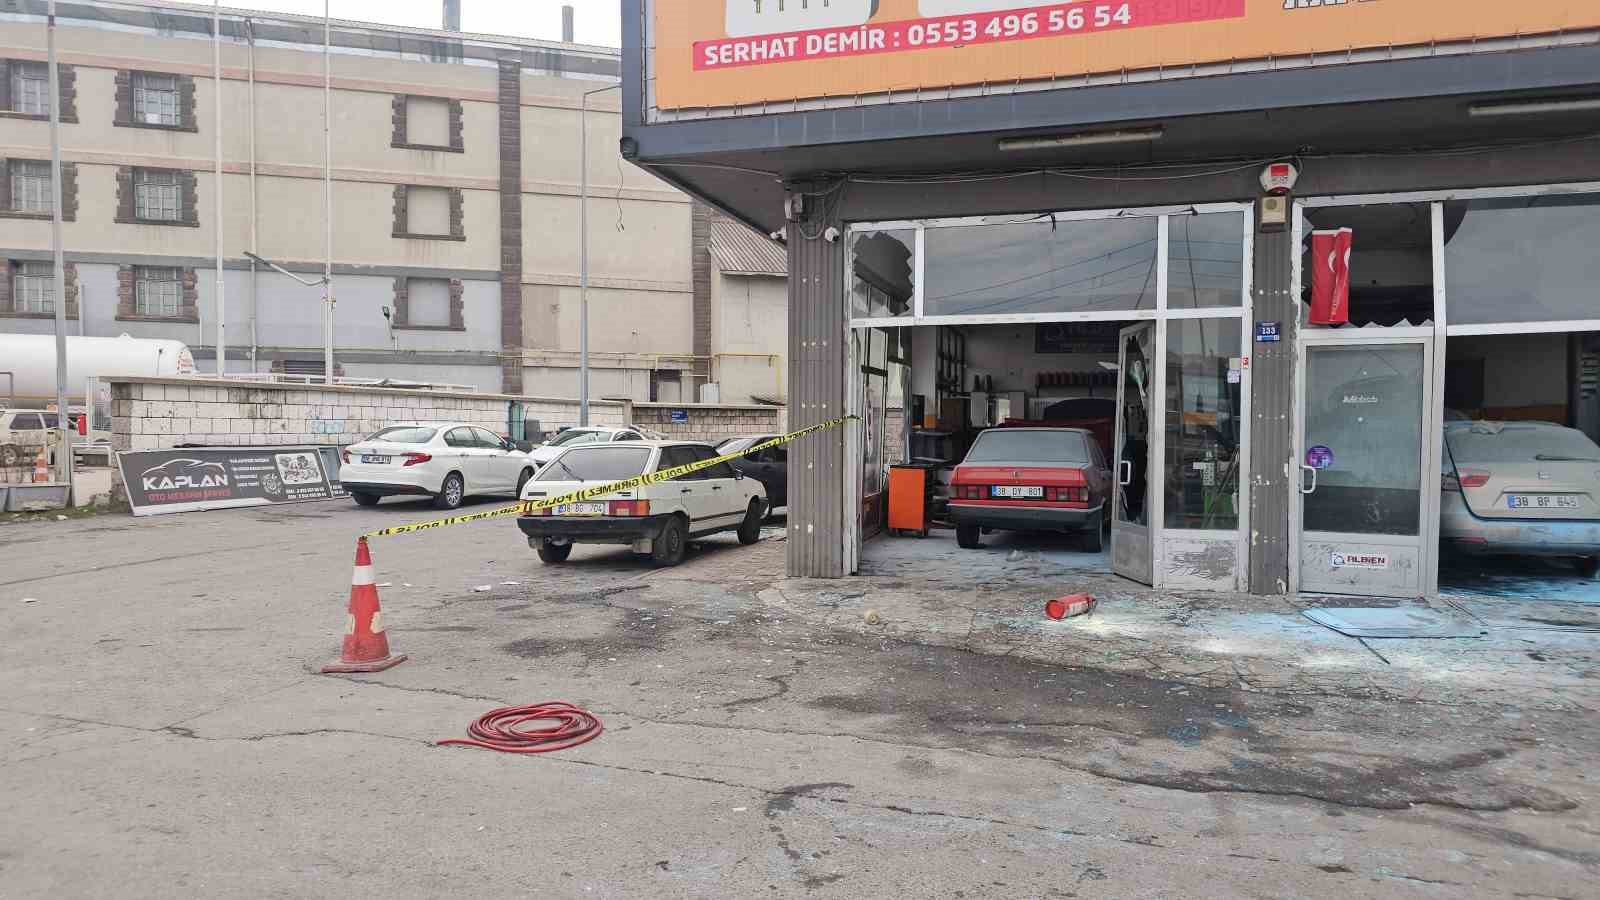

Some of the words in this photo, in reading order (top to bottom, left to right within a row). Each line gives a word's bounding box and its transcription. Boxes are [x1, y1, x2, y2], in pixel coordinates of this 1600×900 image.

[704, 37, 799, 65] SERHAT
[805, 25, 885, 56] DEMİR
[908, 20, 977, 46] 0553
[984, 12, 1039, 38] 496
[1048, 8, 1084, 32] 56
[1093, 3, 1131, 27] 54
[143, 474, 229, 491] KAPLAN
[1515, 497, 1528, 506] 38
